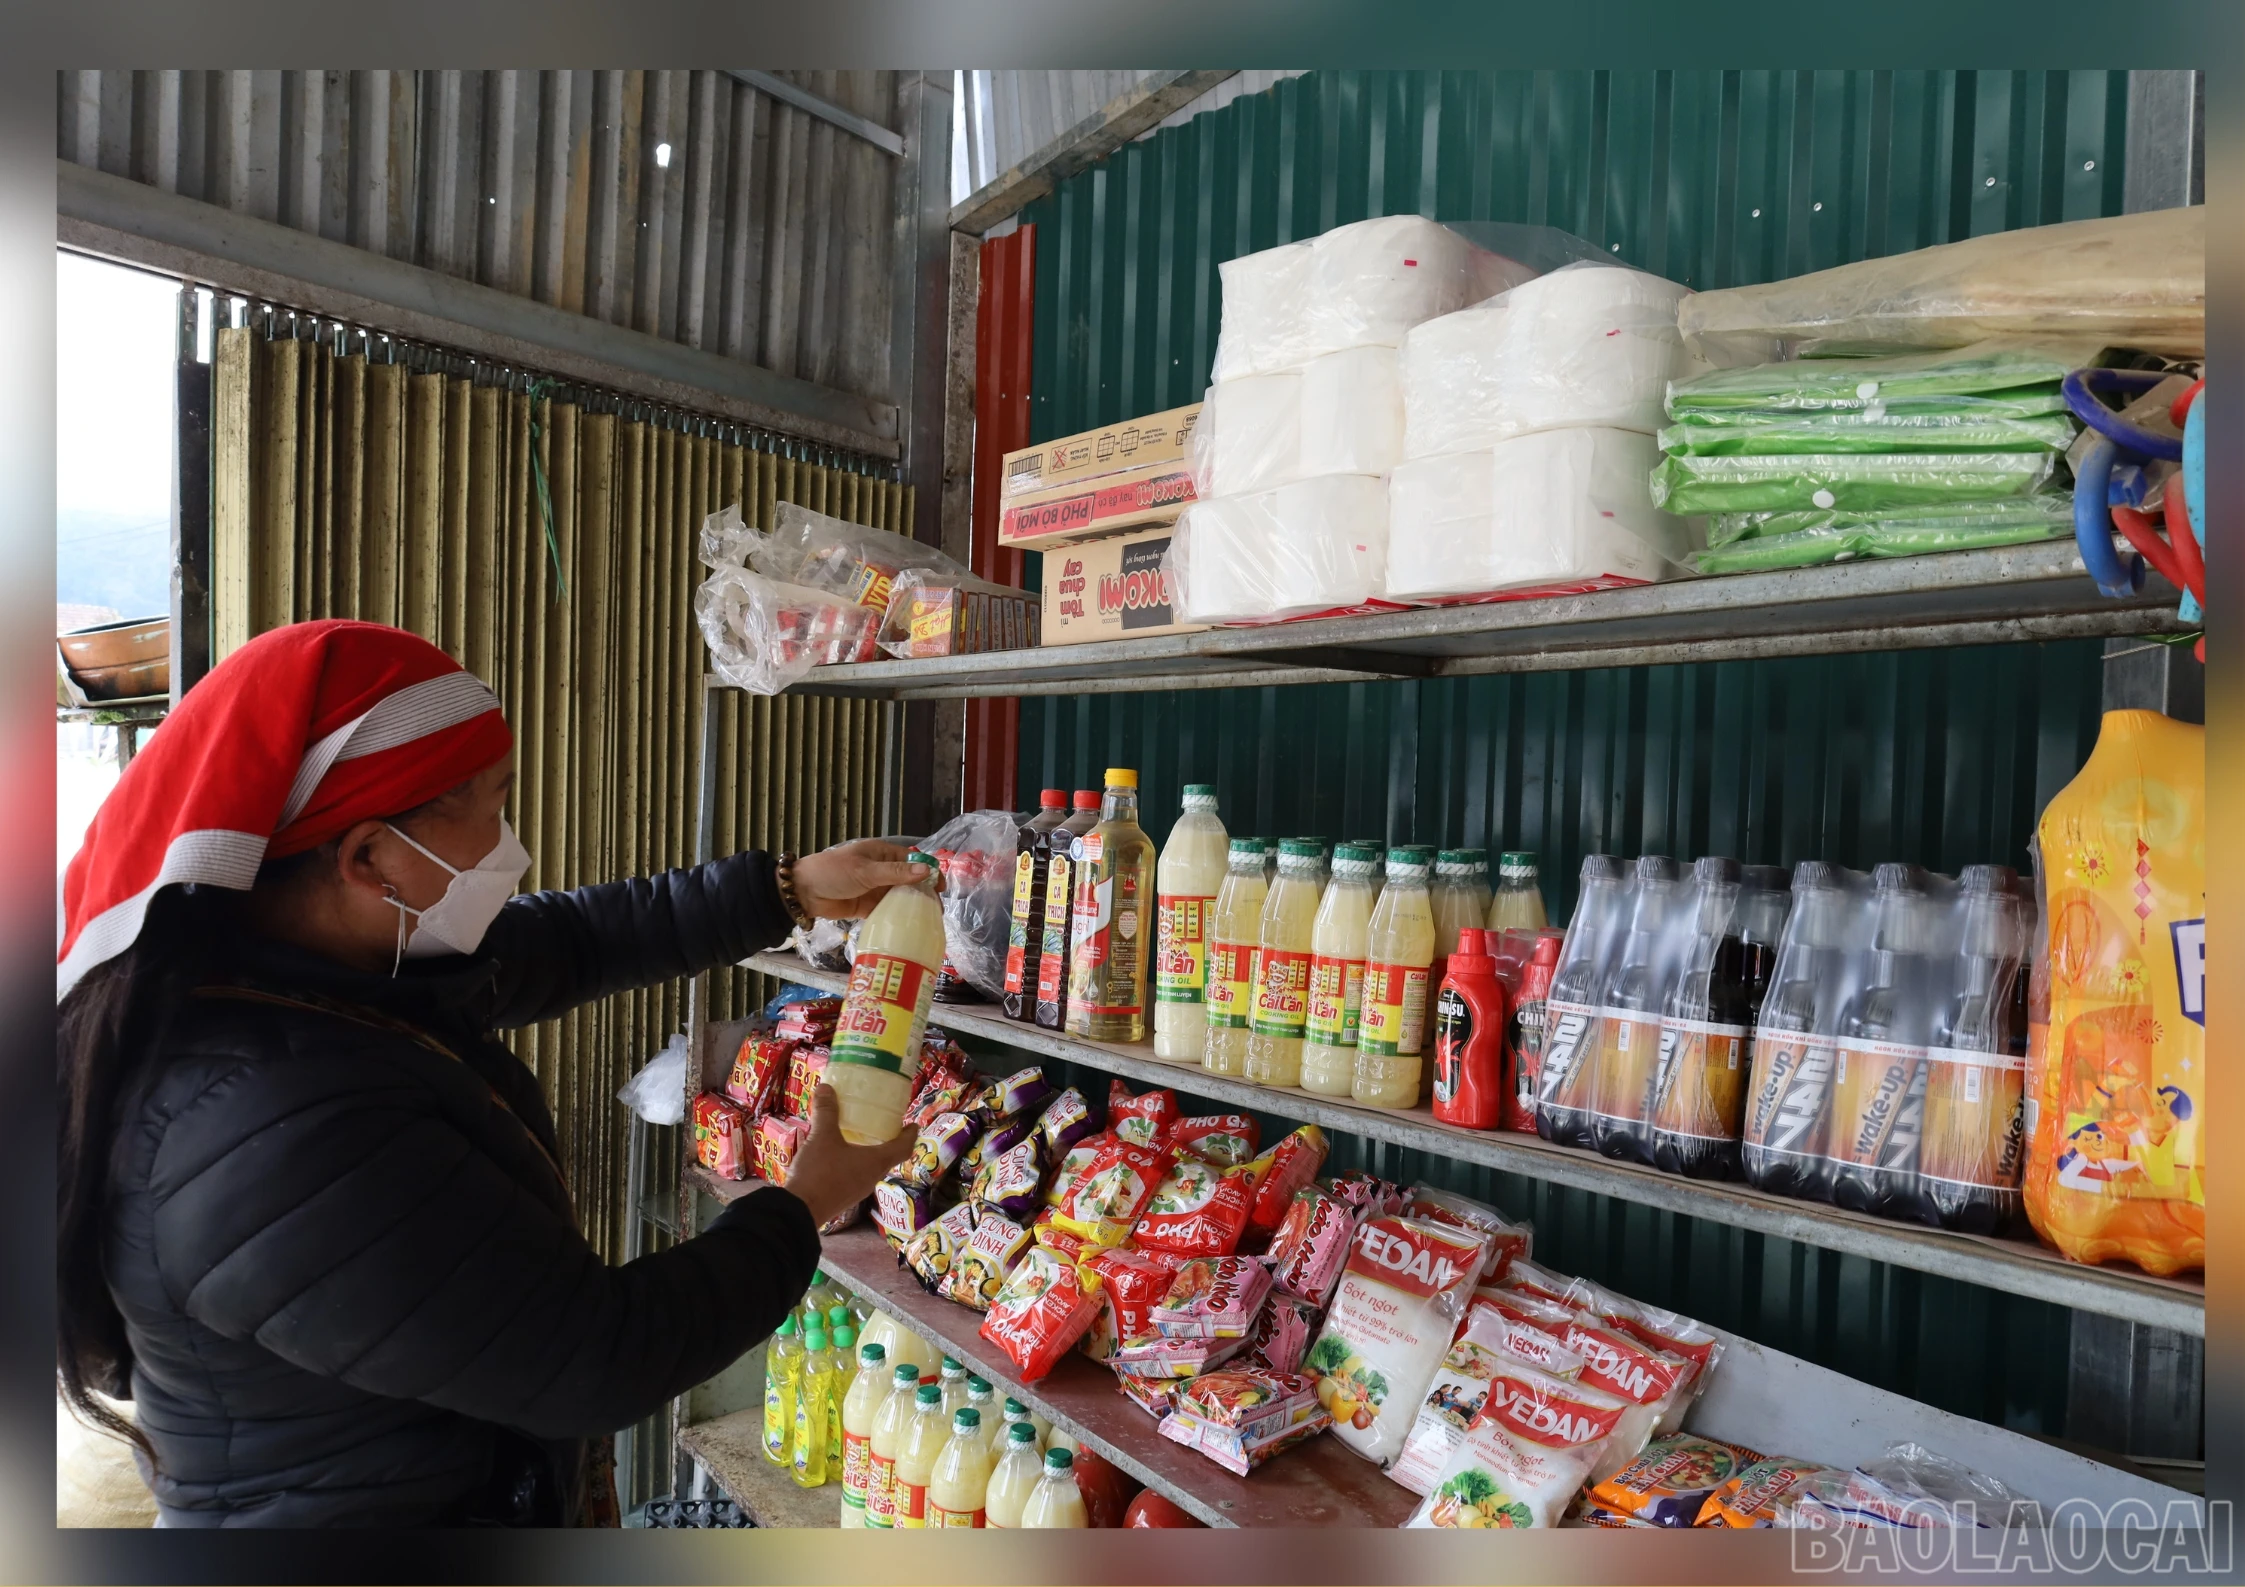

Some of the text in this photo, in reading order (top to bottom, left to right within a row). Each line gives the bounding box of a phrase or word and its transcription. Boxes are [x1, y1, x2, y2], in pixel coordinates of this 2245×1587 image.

[1016, 511, 1040, 532] MỚI
[1042, 507, 1059, 530] BÒ
[1061, 502, 1089, 527] PHỞ
[1062, 558, 1083, 578] cay
[1059, 576, 1086, 597] chua
[1060, 599, 1085, 619] Tôm
[1074, 902, 1098, 915] Neptune
[1177, 977, 1192, 985] OIL
[1260, 1010, 1289, 1019] COOKING
[1437, 1000, 1465, 1017] HIN-SU
[863, 1037, 878, 1046] OIL
[1771, 1046, 1834, 1149] 247
[1010, 1144, 1029, 1187] CUNG
[877, 1188, 905, 1215] CUNG
[981, 1216, 1020, 1243] CUNG
[970, 1231, 1008, 1257] ĐÌNH
[1343, 1282, 1400, 1317] Bột ngọt
[1122, 1310, 1136, 1341] PH
[1341, 1304, 1357, 1317] hiết
[1369, 1316, 1388, 1332] 99%
[1388, 1324, 1405, 1340] trở
[1404, 1332, 1419, 1346] lên
[1358, 1324, 1392, 1346] Glutamate
[1508, 1332, 1551, 1364] VEDAN
[1566, 1326, 1654, 1400] VEDAN
[1495, 1381, 1601, 1444] VEDAN
[1492, 1432, 1545, 1467] Bột ngọt
[1613, 1457, 1651, 1486] Bột Canh
